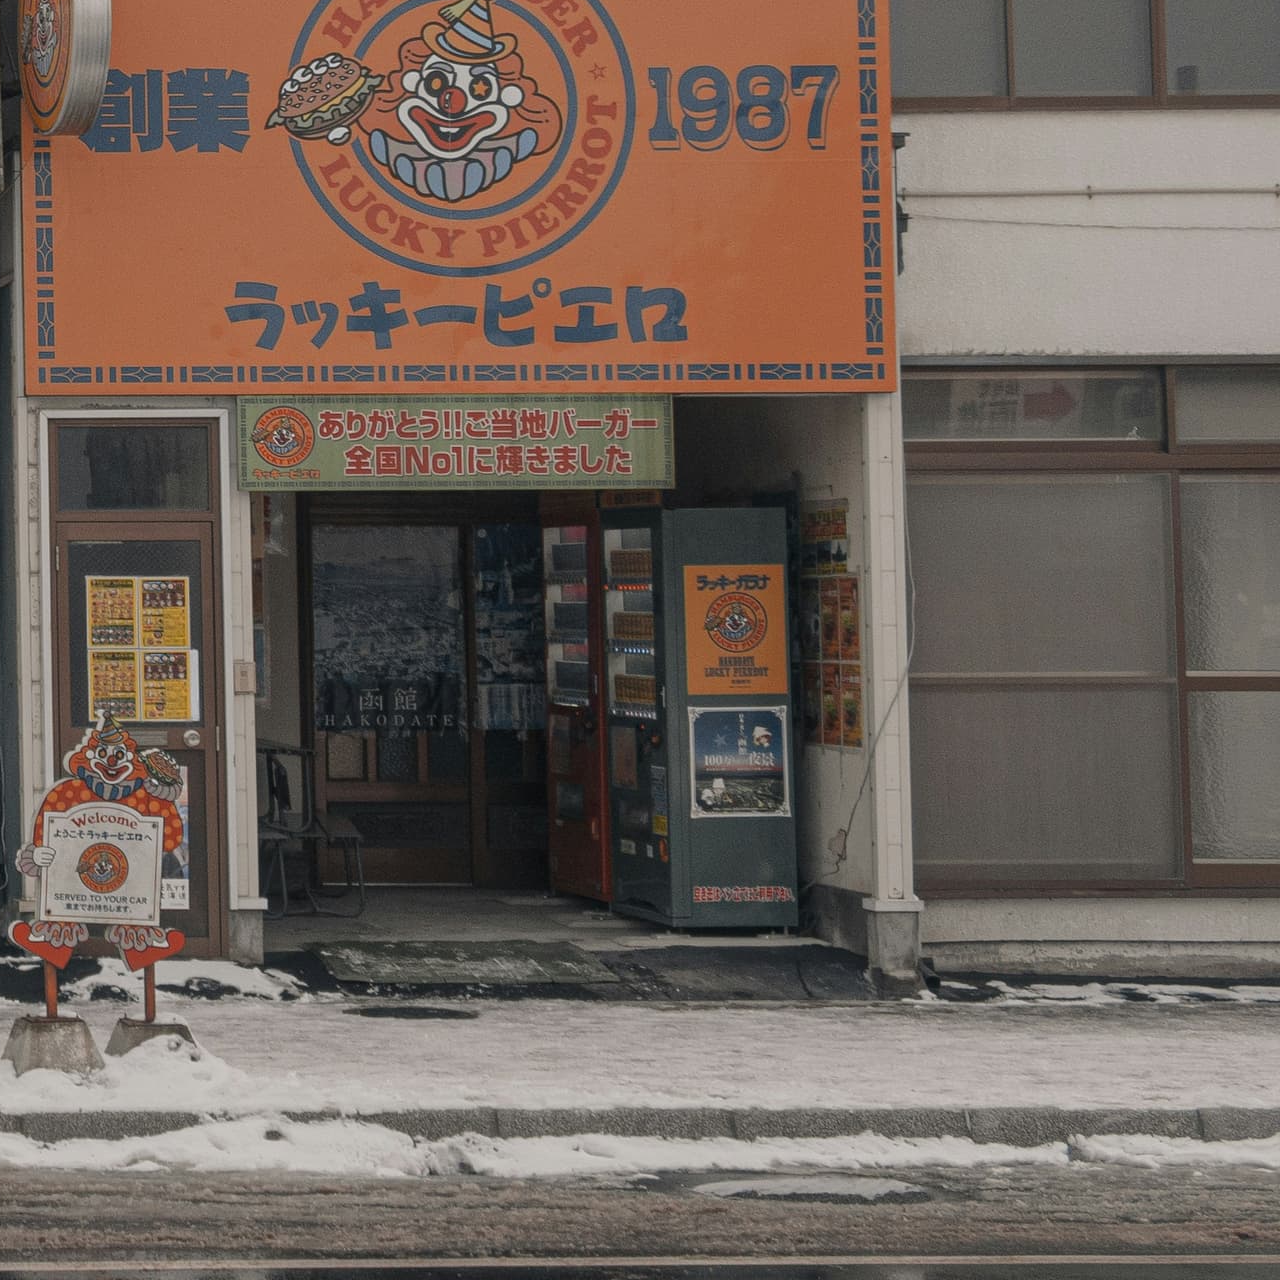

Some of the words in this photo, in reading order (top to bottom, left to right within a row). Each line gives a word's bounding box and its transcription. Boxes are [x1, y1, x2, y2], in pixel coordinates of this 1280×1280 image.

[82, 66, 251, 154] 創業
[648, 65, 839, 152] 1987
[318, 154, 461, 260] LUCKY
[478, 93, 620, 258] PIERROT
[225, 276, 689, 350] ラッキーピエロ
[260, 408, 309, 429] HAMBURGER
[316, 408, 659, 442] ありがとう!!ご当地バーガー
[258, 444, 285, 464] LUCKY
[287, 434, 313, 463] PIERROT
[343, 444, 634, 478] 全国No1に輝きました
[252, 468, 322, 480] ラッキーピエロ
[358, 687, 418, 711] 函館
[324, 714, 454, 728] HAKODATE
[70, 812, 138, 830] Welcome
[54, 892, 87, 902] SERVED
[90, 894, 102, 902] TO
[104, 895, 128, 904] YOUR
[129, 896, 148, 905] CAR
